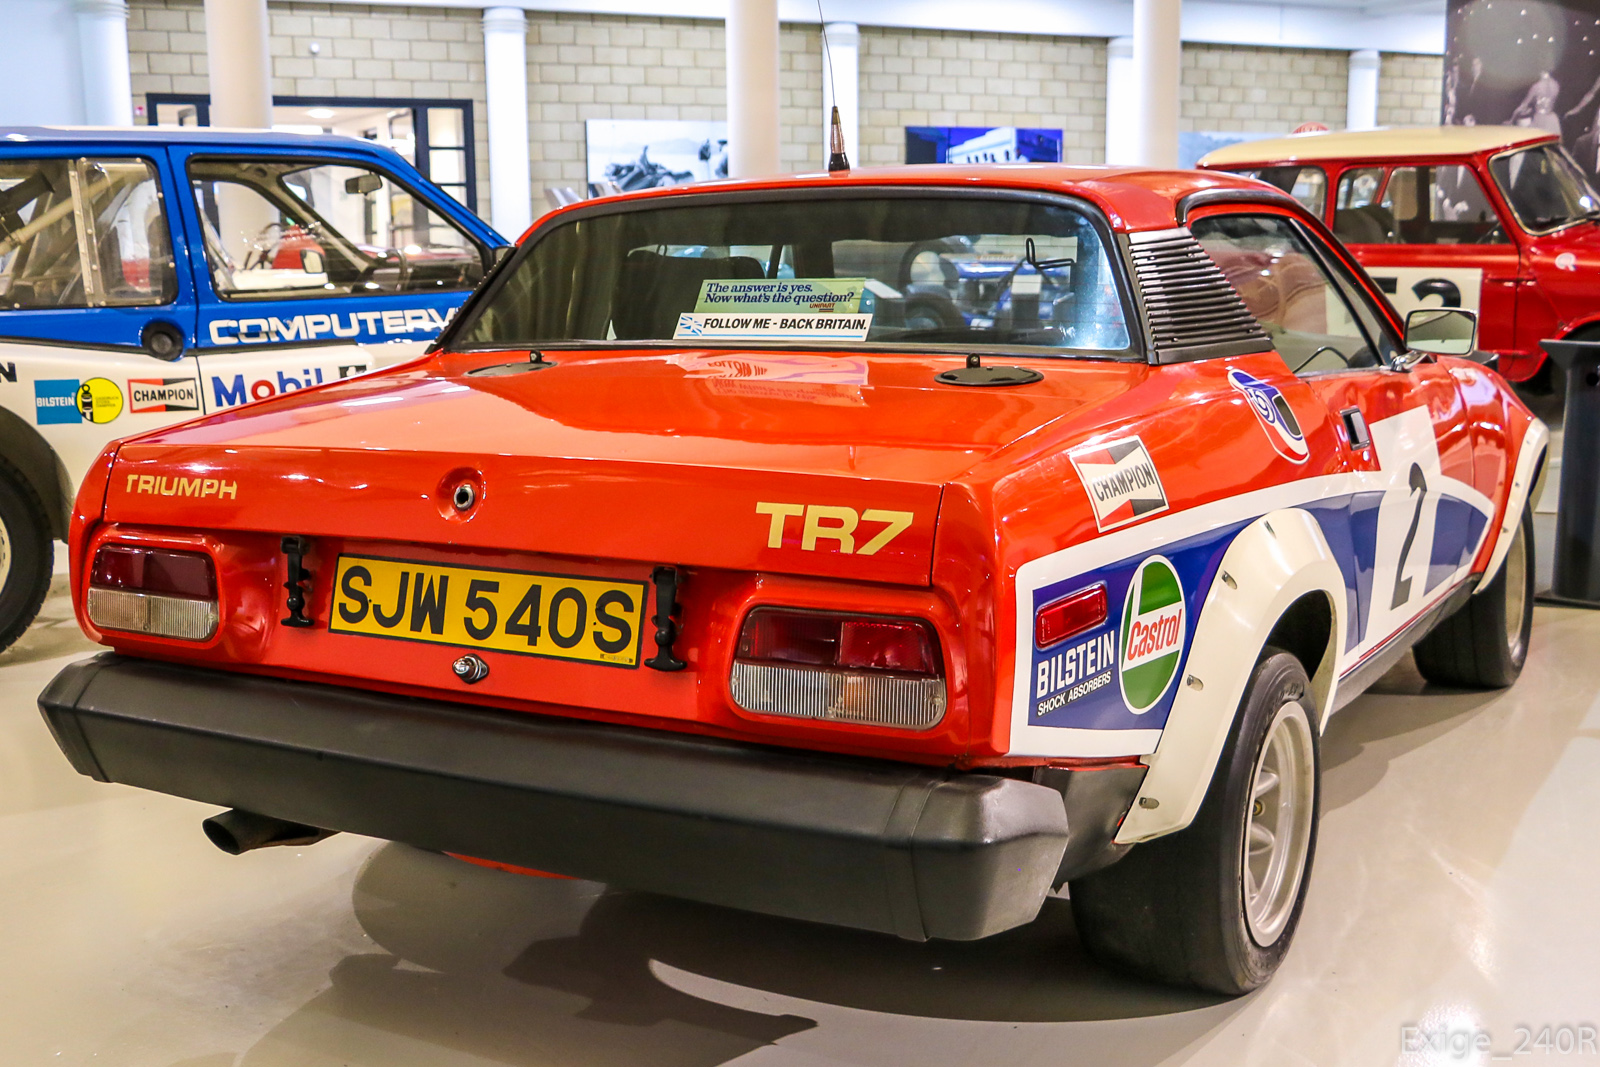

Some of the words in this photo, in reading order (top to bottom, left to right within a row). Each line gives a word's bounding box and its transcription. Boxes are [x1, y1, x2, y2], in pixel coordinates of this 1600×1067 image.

[704, 293, 733, 303] Now
[733, 292, 770, 303] what's
[770, 293, 792, 303] the
[793, 291, 855, 306] question?
[706, 282, 730, 293] The
[731, 283, 776, 293] answer
[777, 282, 788, 292] is
[788, 284, 813, 295] yes.
[208, 307, 459, 344] COMPUTERV
[703, 318, 752, 329] FOLLOW
[752, 318, 770, 329] ME
[779, 318, 814, 329] BACK
[815, 319, 867, 330] BRITAIN.
[36, 396, 75, 407] BILSTEIN
[133, 389, 194, 402] CHAMPION
[126, 474, 238, 500] TRIUMPH
[1092, 462, 1155, 502] CHAMPION
[755, 501, 914, 556] TR7
[1390, 462, 1427, 610] 2
[338, 565, 449, 636] SJW
[463, 580, 635, 655] 540S
[1127, 608, 1182, 661] Castrol
[1036, 630, 1115, 699] BILSTEIN
[1037, 692, 1066, 717] SHOCK
[1067, 671, 1112, 705] ABSORBERS
